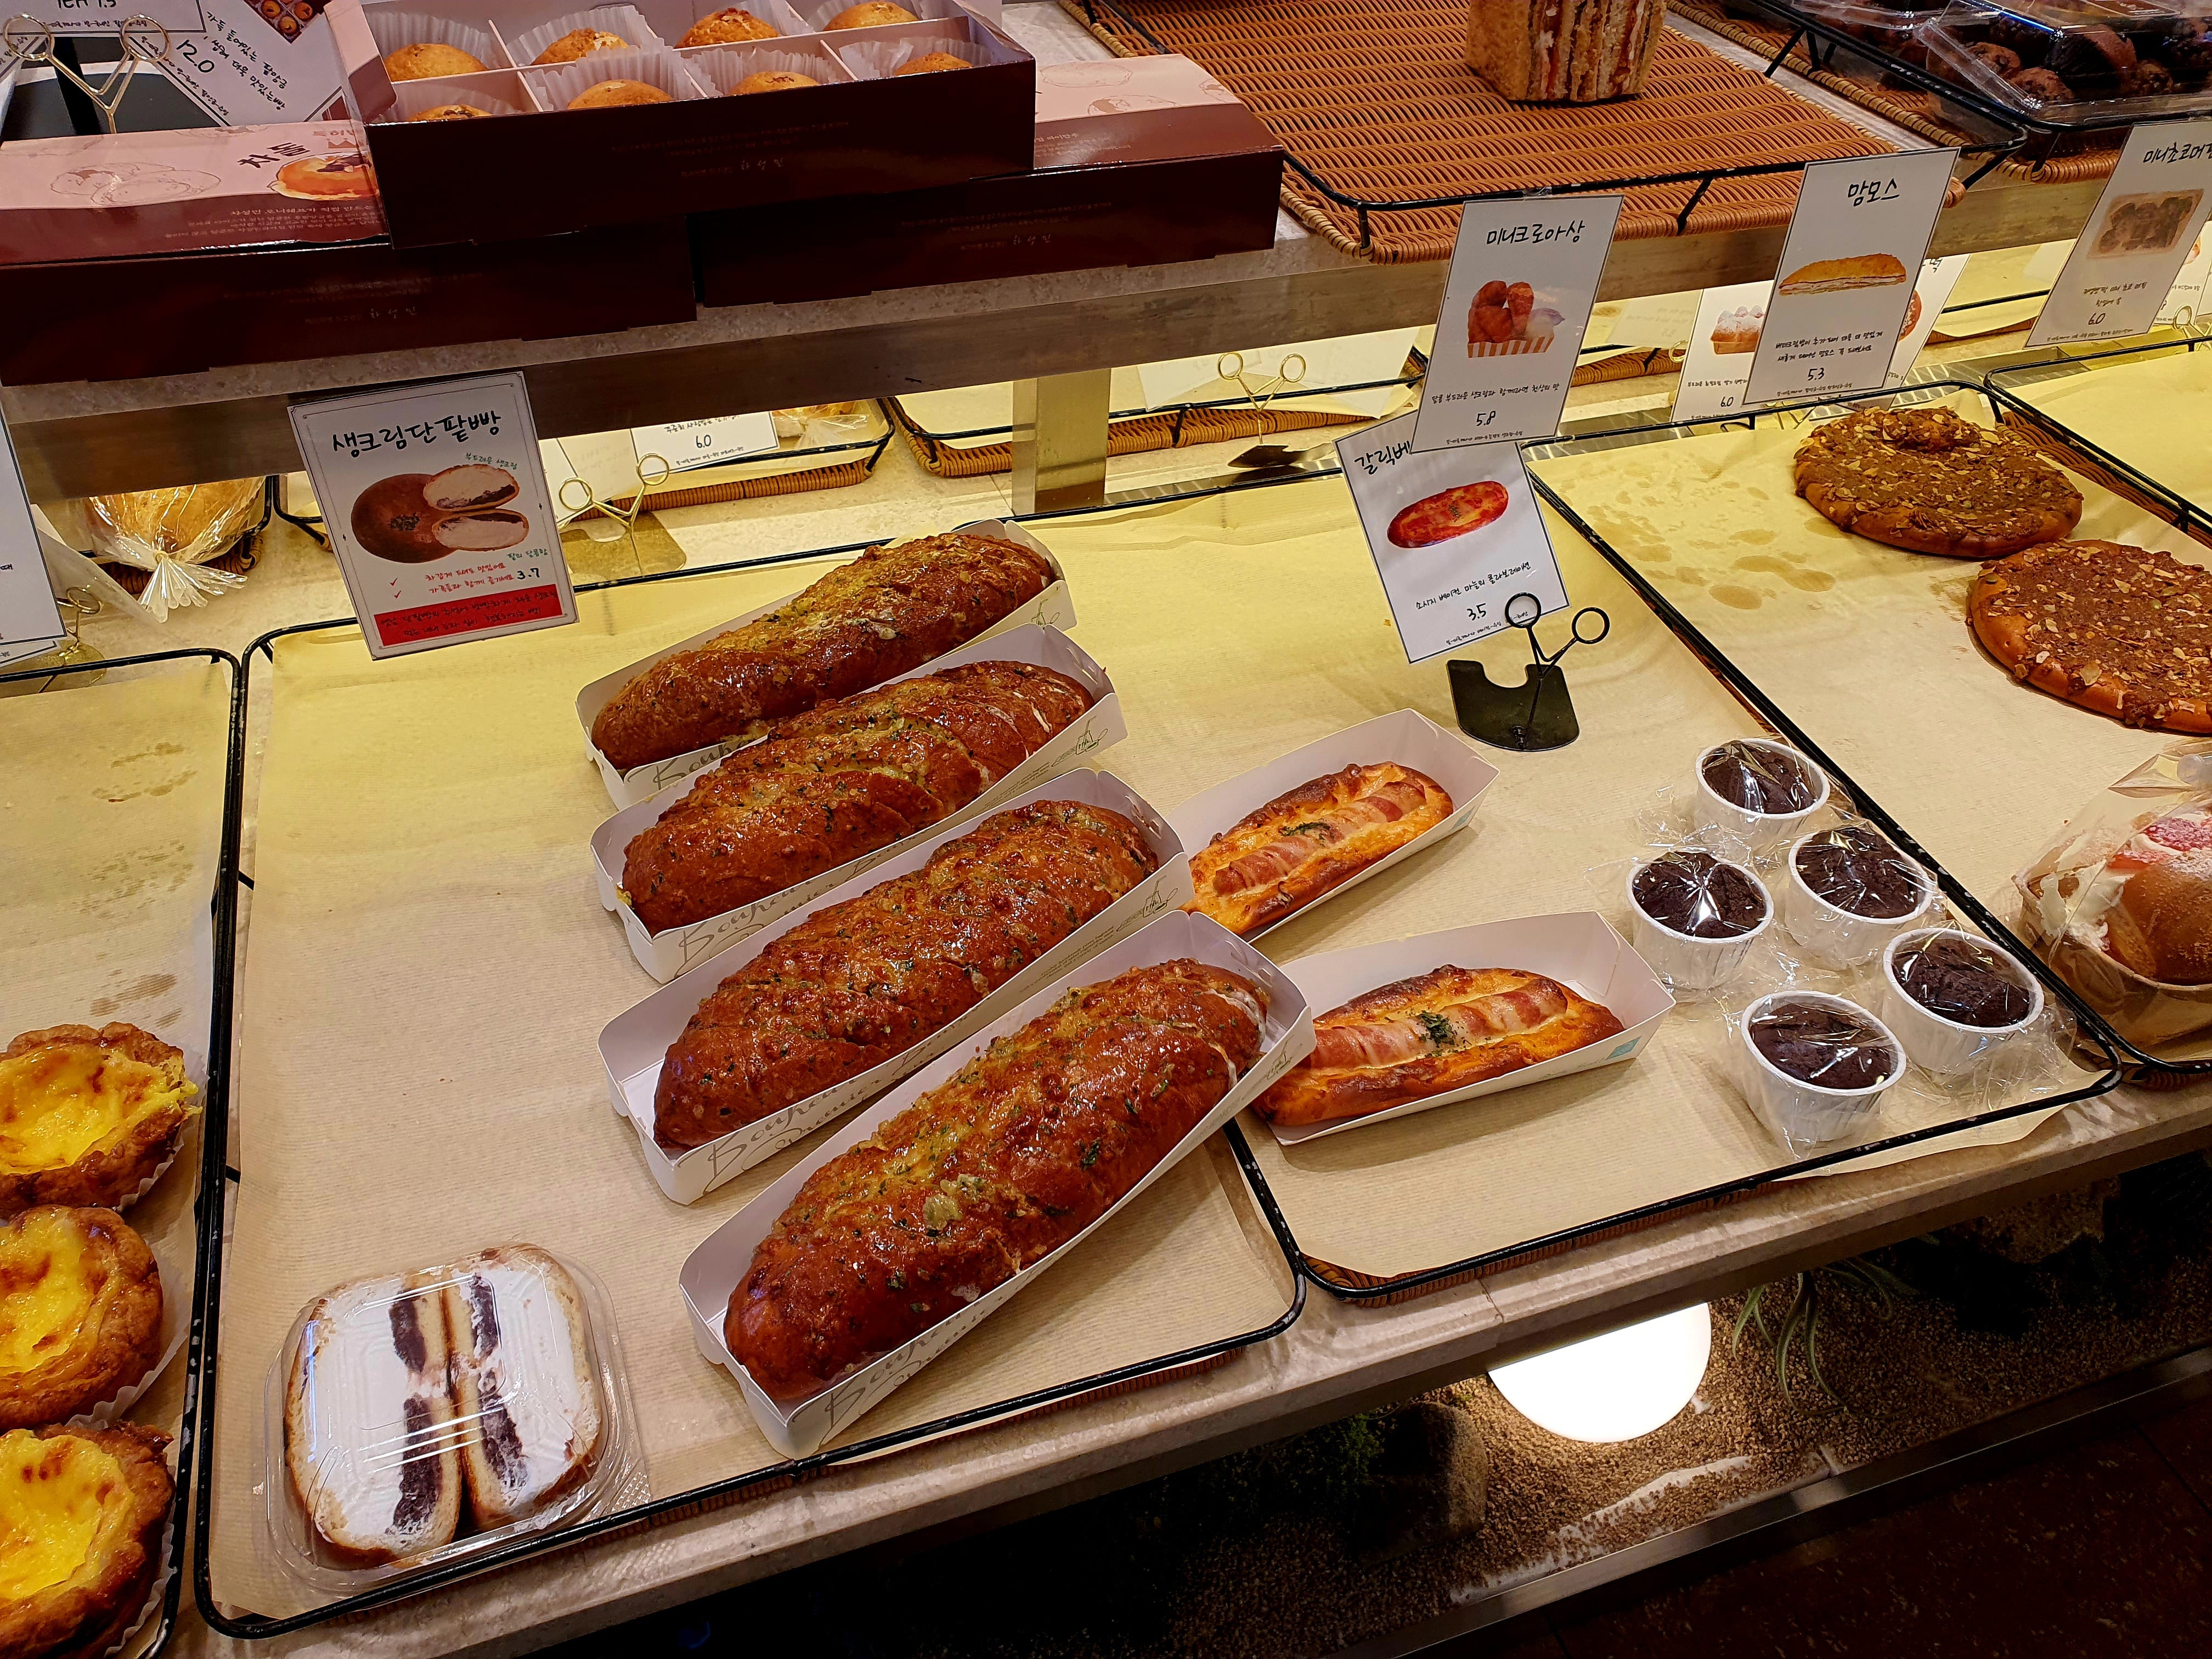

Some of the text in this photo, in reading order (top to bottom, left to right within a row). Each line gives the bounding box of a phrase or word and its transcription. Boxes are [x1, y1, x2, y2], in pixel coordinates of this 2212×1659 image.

[175, 39, 215, 73] 12.0
[1486, 219, 1585, 246] 미니크로아상
[1807, 368, 1825, 382] 5.3
[1720, 396, 1734, 408] 6.0
[1476, 410, 1497, 427] 5.8
[332, 409, 502, 458] 생크림단팥빵
[695, 434, 712, 449] 6.0
[516, 567, 540, 580] 3.7
[1415, 599, 1437, 611] 소시지
[1438, 588, 1462, 605] 베이컨
[1466, 603, 1487, 622] 3.5
